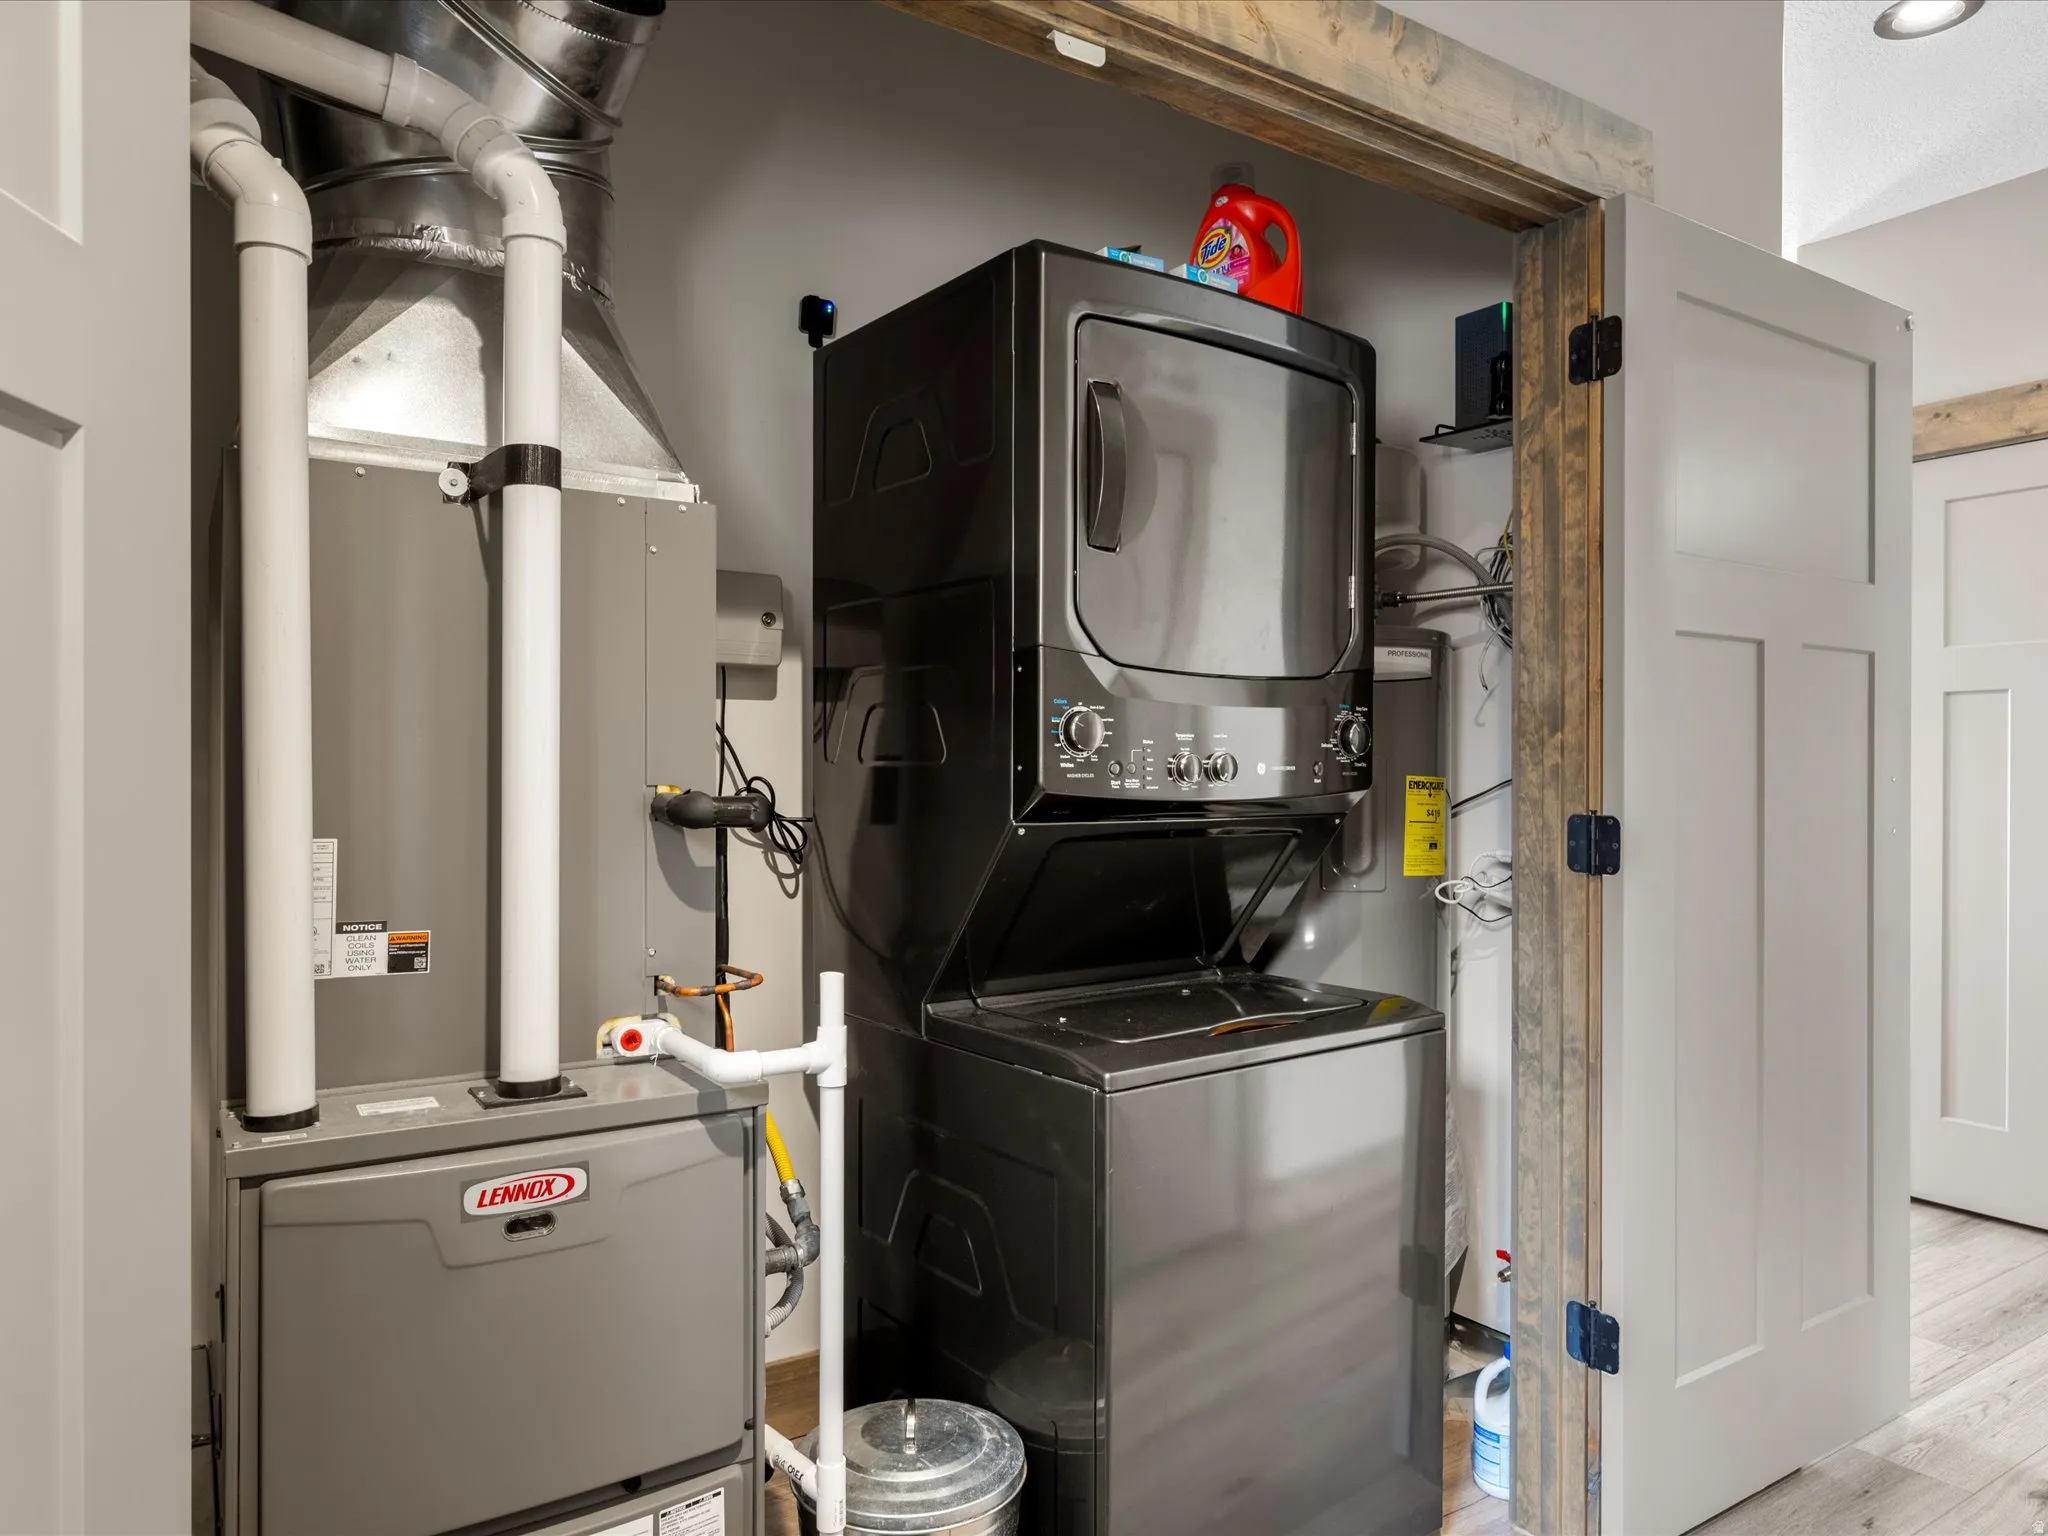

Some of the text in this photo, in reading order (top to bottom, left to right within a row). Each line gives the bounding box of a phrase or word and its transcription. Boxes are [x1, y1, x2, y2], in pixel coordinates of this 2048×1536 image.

[1200, 235, 1227, 265] Tide
[1387, 649, 1430, 659] PROFESSIONAL
[342, 923, 383, 932] NOTICE
[346, 934, 377, 942] CLEAN
[396, 934, 427, 942] WARNING
[347, 949, 375, 957] USING
[347, 964, 372, 972] ONLY
[476, 1177, 557, 1209] LENNOX
